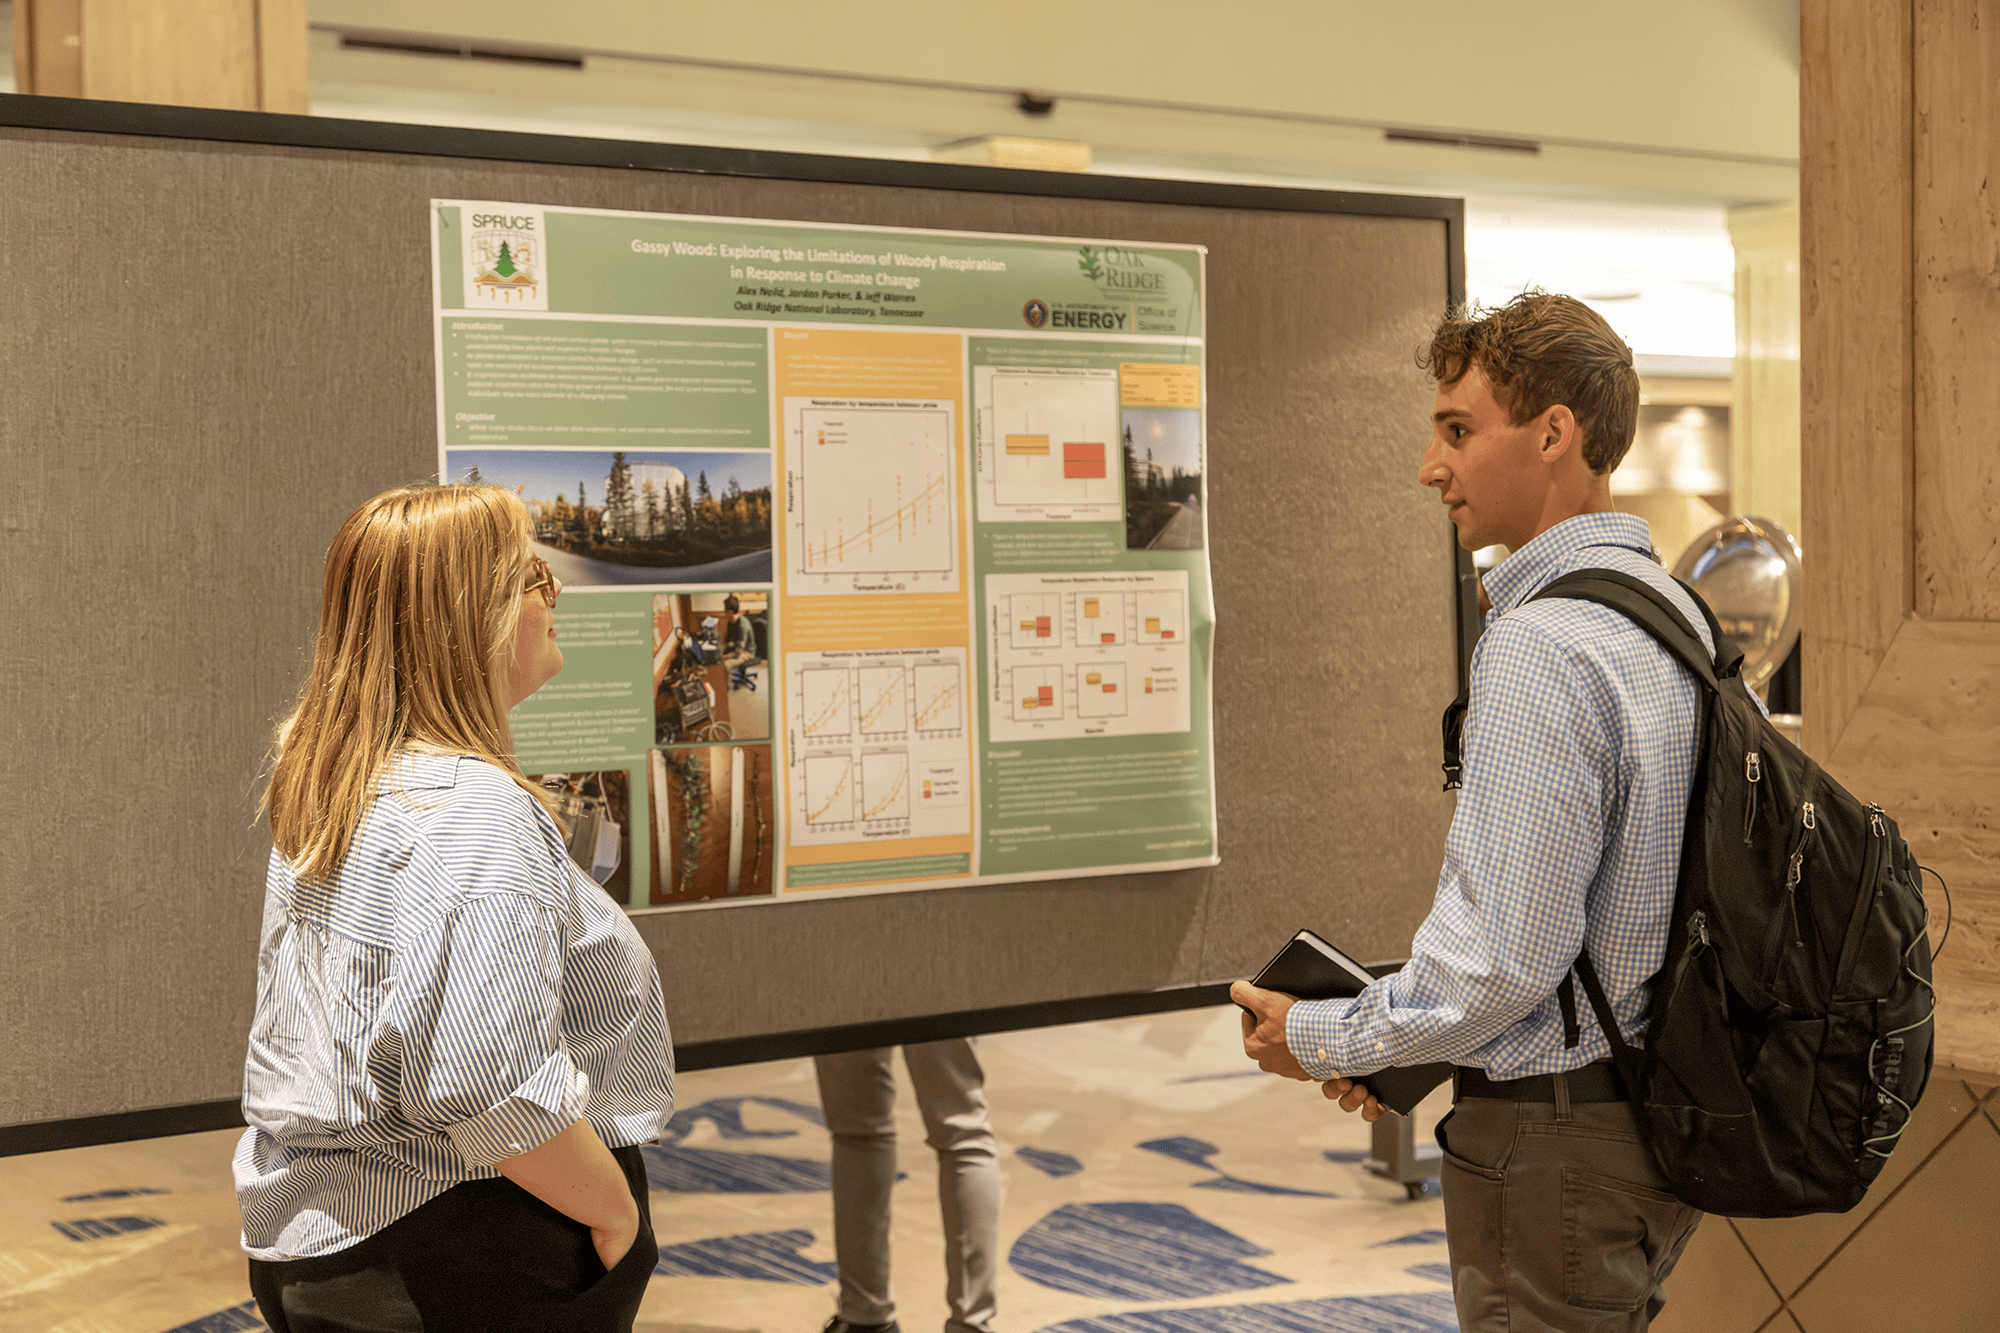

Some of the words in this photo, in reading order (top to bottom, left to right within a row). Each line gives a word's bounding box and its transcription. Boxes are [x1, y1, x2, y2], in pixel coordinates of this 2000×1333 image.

[472, 214, 534, 230] SPRUCE
[631, 239, 670, 257] Gassy
[672, 240, 718, 256] Wood:
[720, 244, 781, 263] Exploring
[782, 247, 804, 261] the
[807, 248, 876, 265] Limitations
[878, 252, 892, 266] of
[894, 253, 937, 271] Woody
[939, 255, 1006, 272] Respiration
[1104, 246, 1146, 268] OAK
[730, 264, 744, 278] in
[746, 266, 807, 283] Response
[810, 269, 823, 283] to
[826, 270, 874, 285] Climate
[874, 272, 921, 290] Change
[1106, 267, 1166, 289] RIDGE
[736, 286, 756, 296] Alex
[855, 290, 862, 300] &
[865, 291, 882, 303] Jeff
[734, 301, 753, 311] Oak
[756, 302, 782, 314] Ridge
[784, 303, 824, 314] National
[880, 306, 925, 318] Tennessee
[1138, 306, 1164, 318] Office
[1052, 310, 1126, 329] ENERGY
[1138, 320, 1176, 332] Science
[455, 412, 496, 422] Objective
